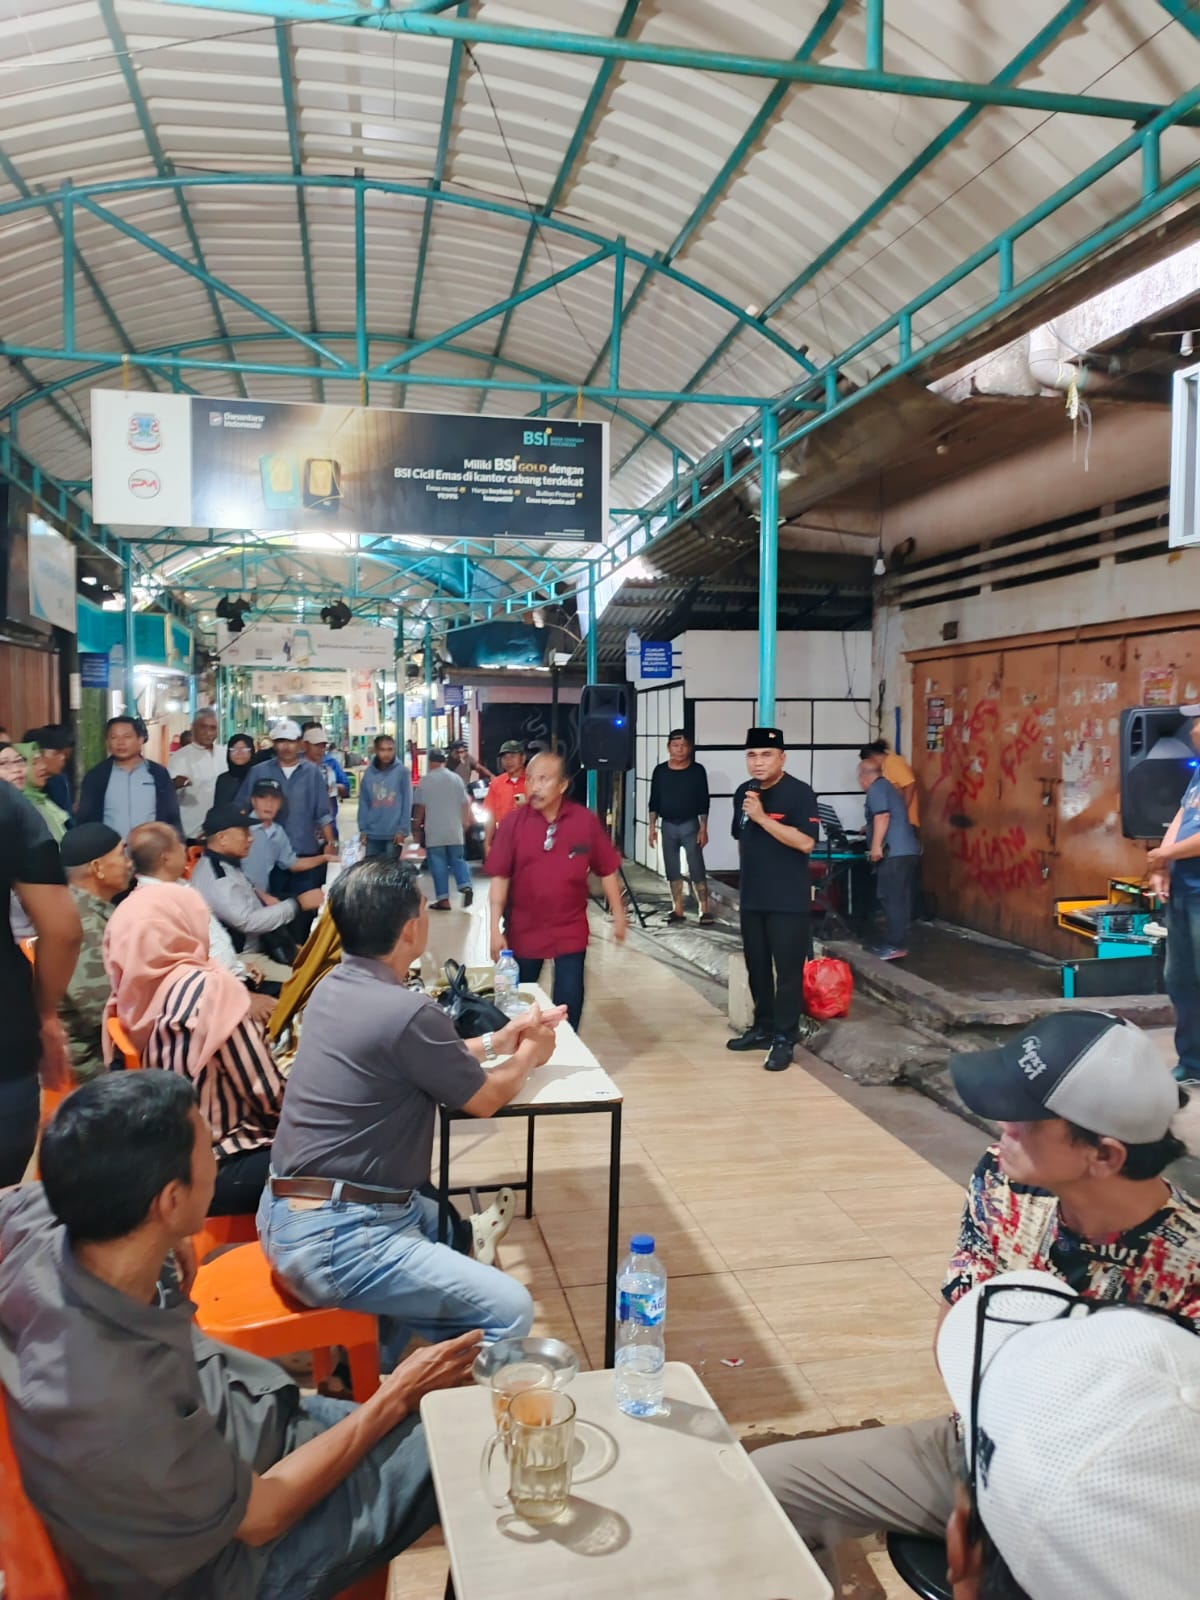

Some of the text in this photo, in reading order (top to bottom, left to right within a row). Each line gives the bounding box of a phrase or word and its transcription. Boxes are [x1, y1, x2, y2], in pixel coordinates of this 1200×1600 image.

[523, 430, 549, 446] BSI
[463, 457, 584, 476] Miliki BSI GOLD dengan
[394, 467, 584, 488] BSI Cicil Emas di kantor cabang terdekat
